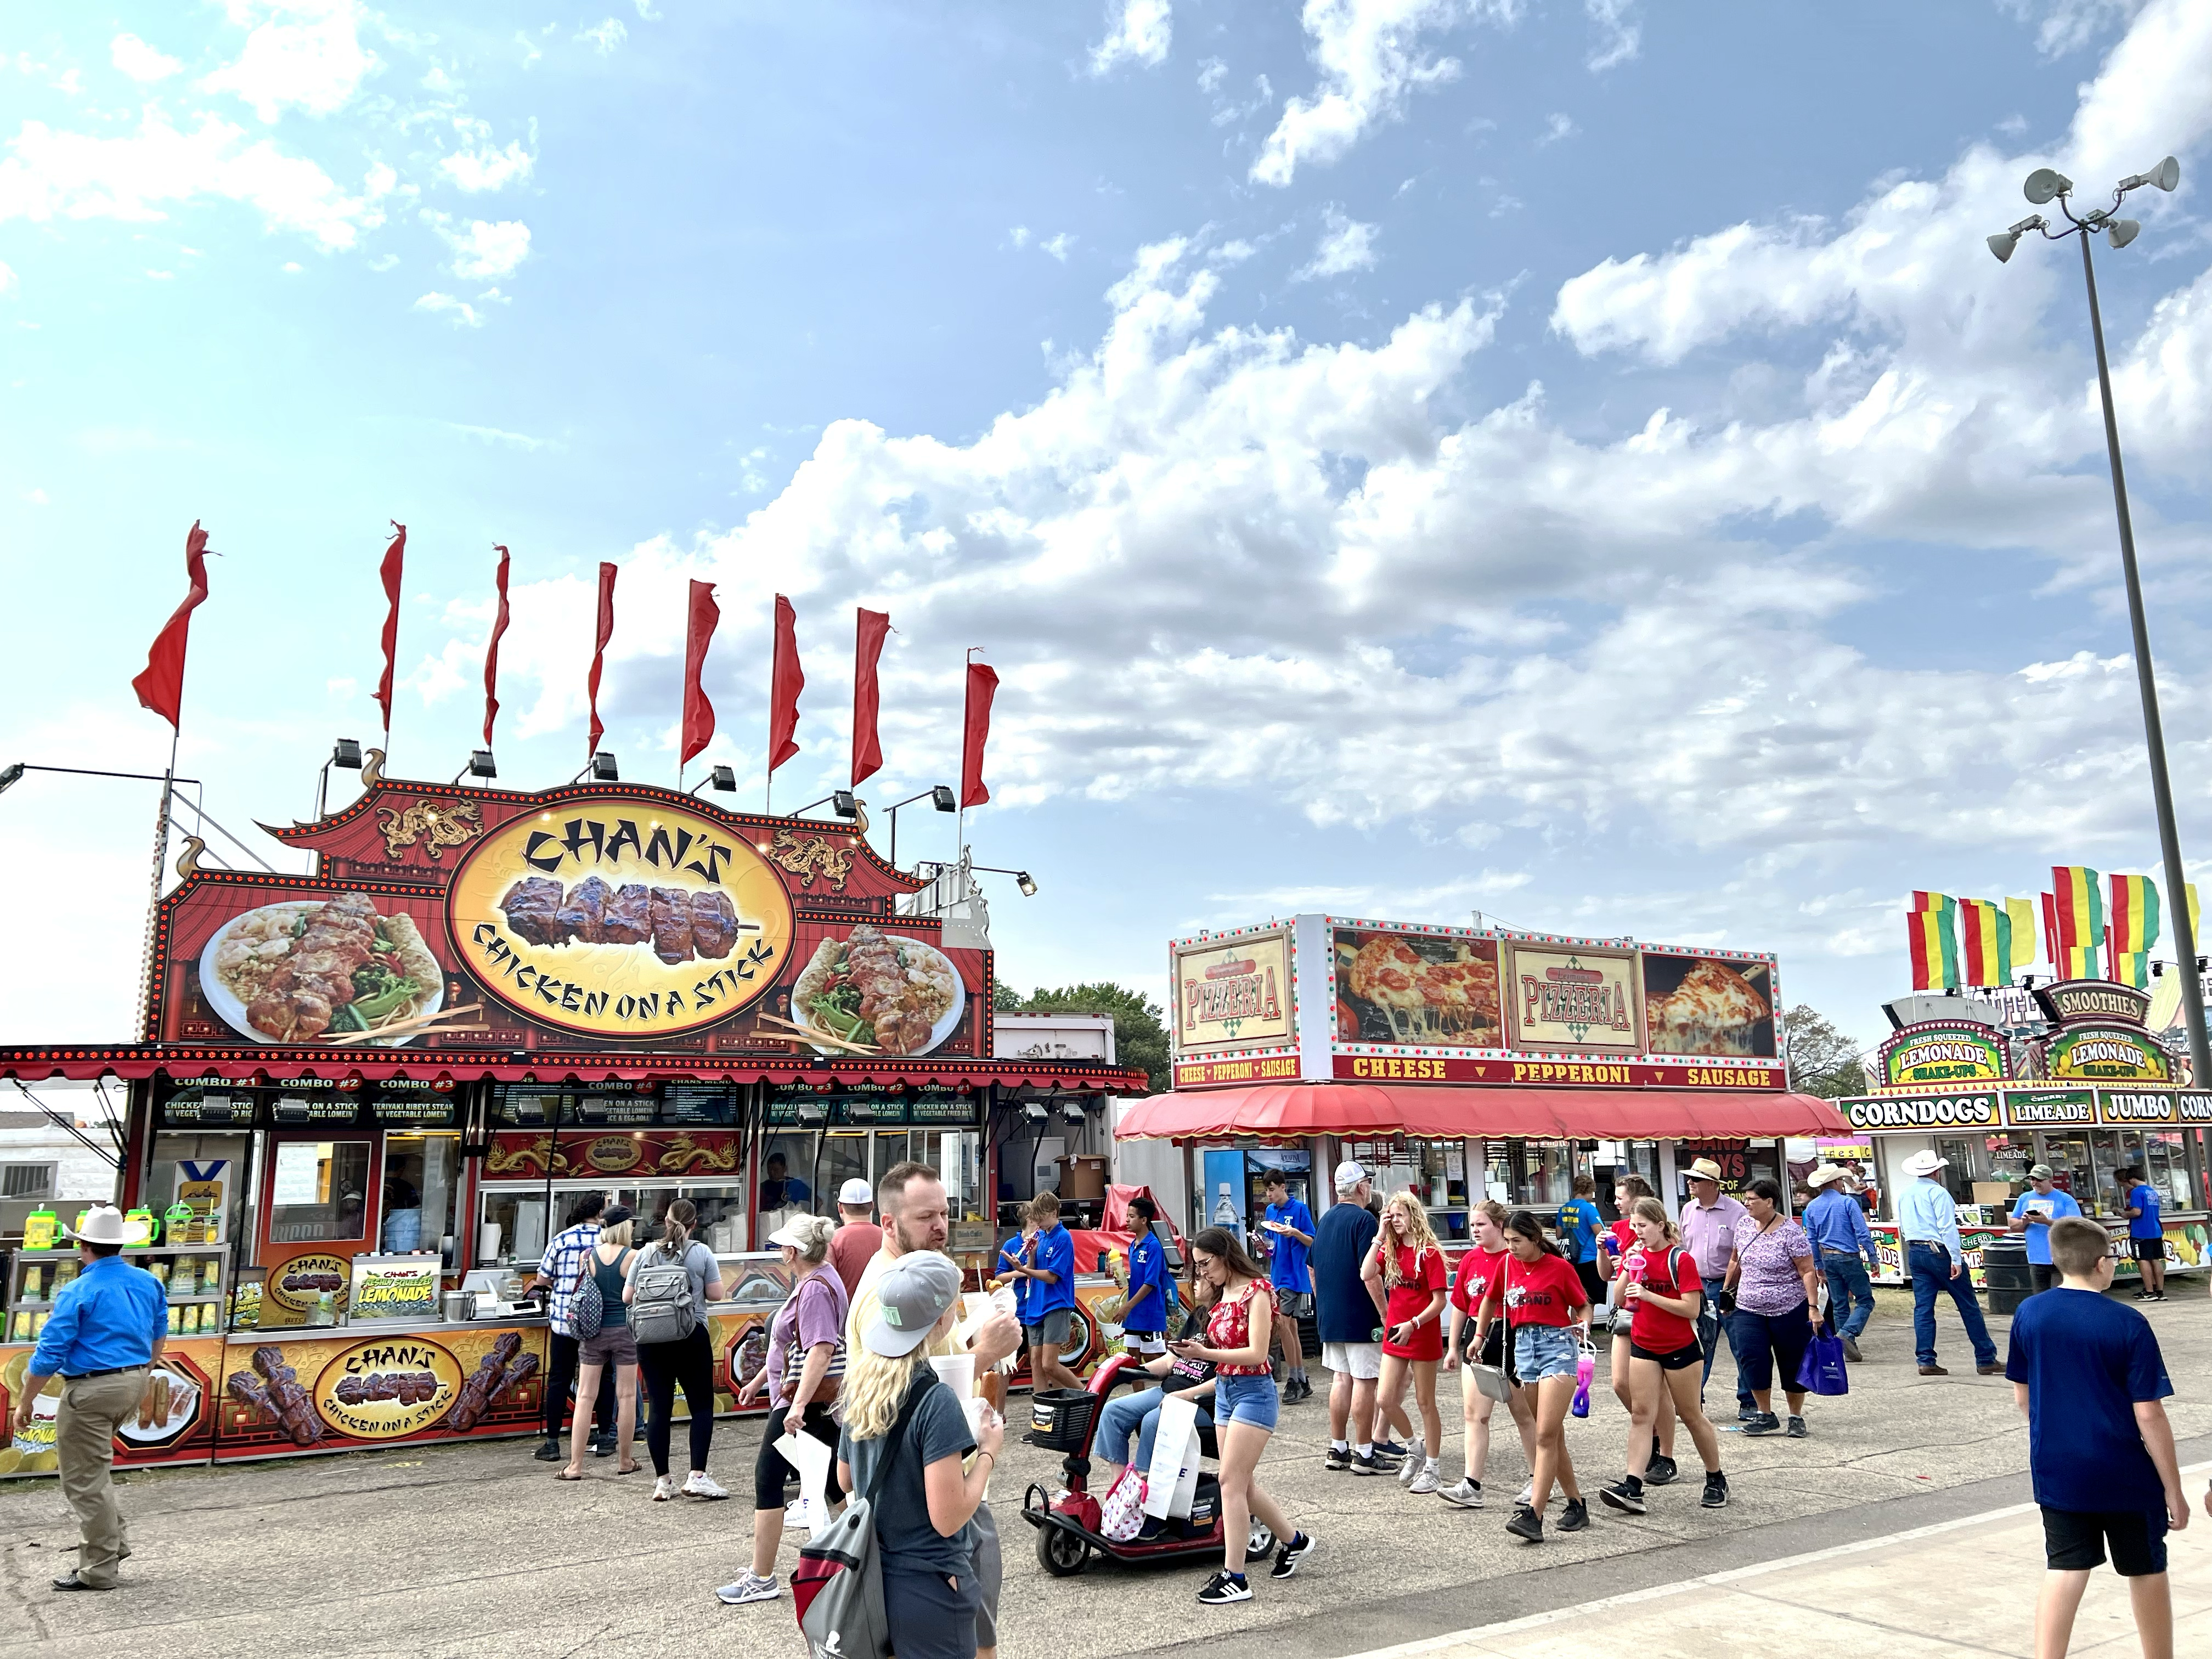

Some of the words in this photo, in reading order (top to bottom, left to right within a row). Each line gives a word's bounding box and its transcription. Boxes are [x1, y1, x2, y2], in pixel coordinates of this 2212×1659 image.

[521, 818, 732, 885] CHAN'S
[472, 921, 610, 1017] CHICKEN
[615, 992, 659, 1021] ON
[664, 990, 686, 1018] A
[693, 938, 775, 1012] STICK
[1184, 966, 1282, 1031] PIZZERIA
[1521, 974, 1631, 1031] PIZZERIA
[2062, 991, 2139, 1017] SMOOTHIES
[1910, 1034, 1932, 1047] FRESH
[1933, 1033, 1972, 1042] SQUEEZED
[2078, 1031, 2100, 1041] FRESH
[2100, 1031, 2133, 1043] SQUEEZED
[1899, 1043, 1988, 1070] LEMONADE
[2071, 1042, 2146, 1069] LEMONADE
[1180, 1065, 1205, 1084] CHEESE
[1212, 1062, 1252, 1081] PEPPERONI
[1261, 1058, 1296, 1077] SAUSAGE
[1353, 1058, 1447, 1079] CHEESE
[1513, 1063, 1630, 1084] PEPPERONI
[1913, 1064, 1976, 1080] SHAKE-UPS
[2083, 1065, 2137, 1077] SHAKE-UPS
[174, 1077, 231, 1086] COMBO
[235, 1077, 256, 1086] #1
[280, 1079, 334, 1088] COMBO
[338, 1078, 359, 1088] #2
[379, 1080, 430, 1089] COMBO
[434, 1080, 454, 1089] #3
[1687, 1068, 1771, 1086] SAUSAGE
[588, 1082, 633, 1090] COMBO
[636, 1081, 653, 1090] #4
[816, 1083, 832, 1091] #3
[956, 1084, 970, 1092] #1
[2030, 1094, 2068, 1103] CHERRY
[1849, 1097, 1992, 1128] CORNDOGS
[2014, 1104, 2090, 1122] LIMEADE
[2107, 1094, 2171, 1120] JUMBO
[1689, 1138, 1745, 1151] BAND
[1996, 1148, 2028, 1160] LIMEADE
[1961, 1232, 1993, 1247] CHERRY
[287, 1259, 342, 1274] CHAN'S
[383, 1270, 418, 1278] CHAN'S
[360, 1278, 394, 1288] FRESHLY
[394, 1277, 434, 1287] SQUEEZED
[358, 1286, 432, 1304] LEMONADE
[1518, 1295, 1553, 1306] BAND
[345, 1346, 435, 1374] CHAN'S
[323, 1398, 380, 1432] CHICKEN
[381, 1419, 400, 1431] ON
[404, 1417, 411, 1429] A
[416, 1390, 453, 1424] STICK
